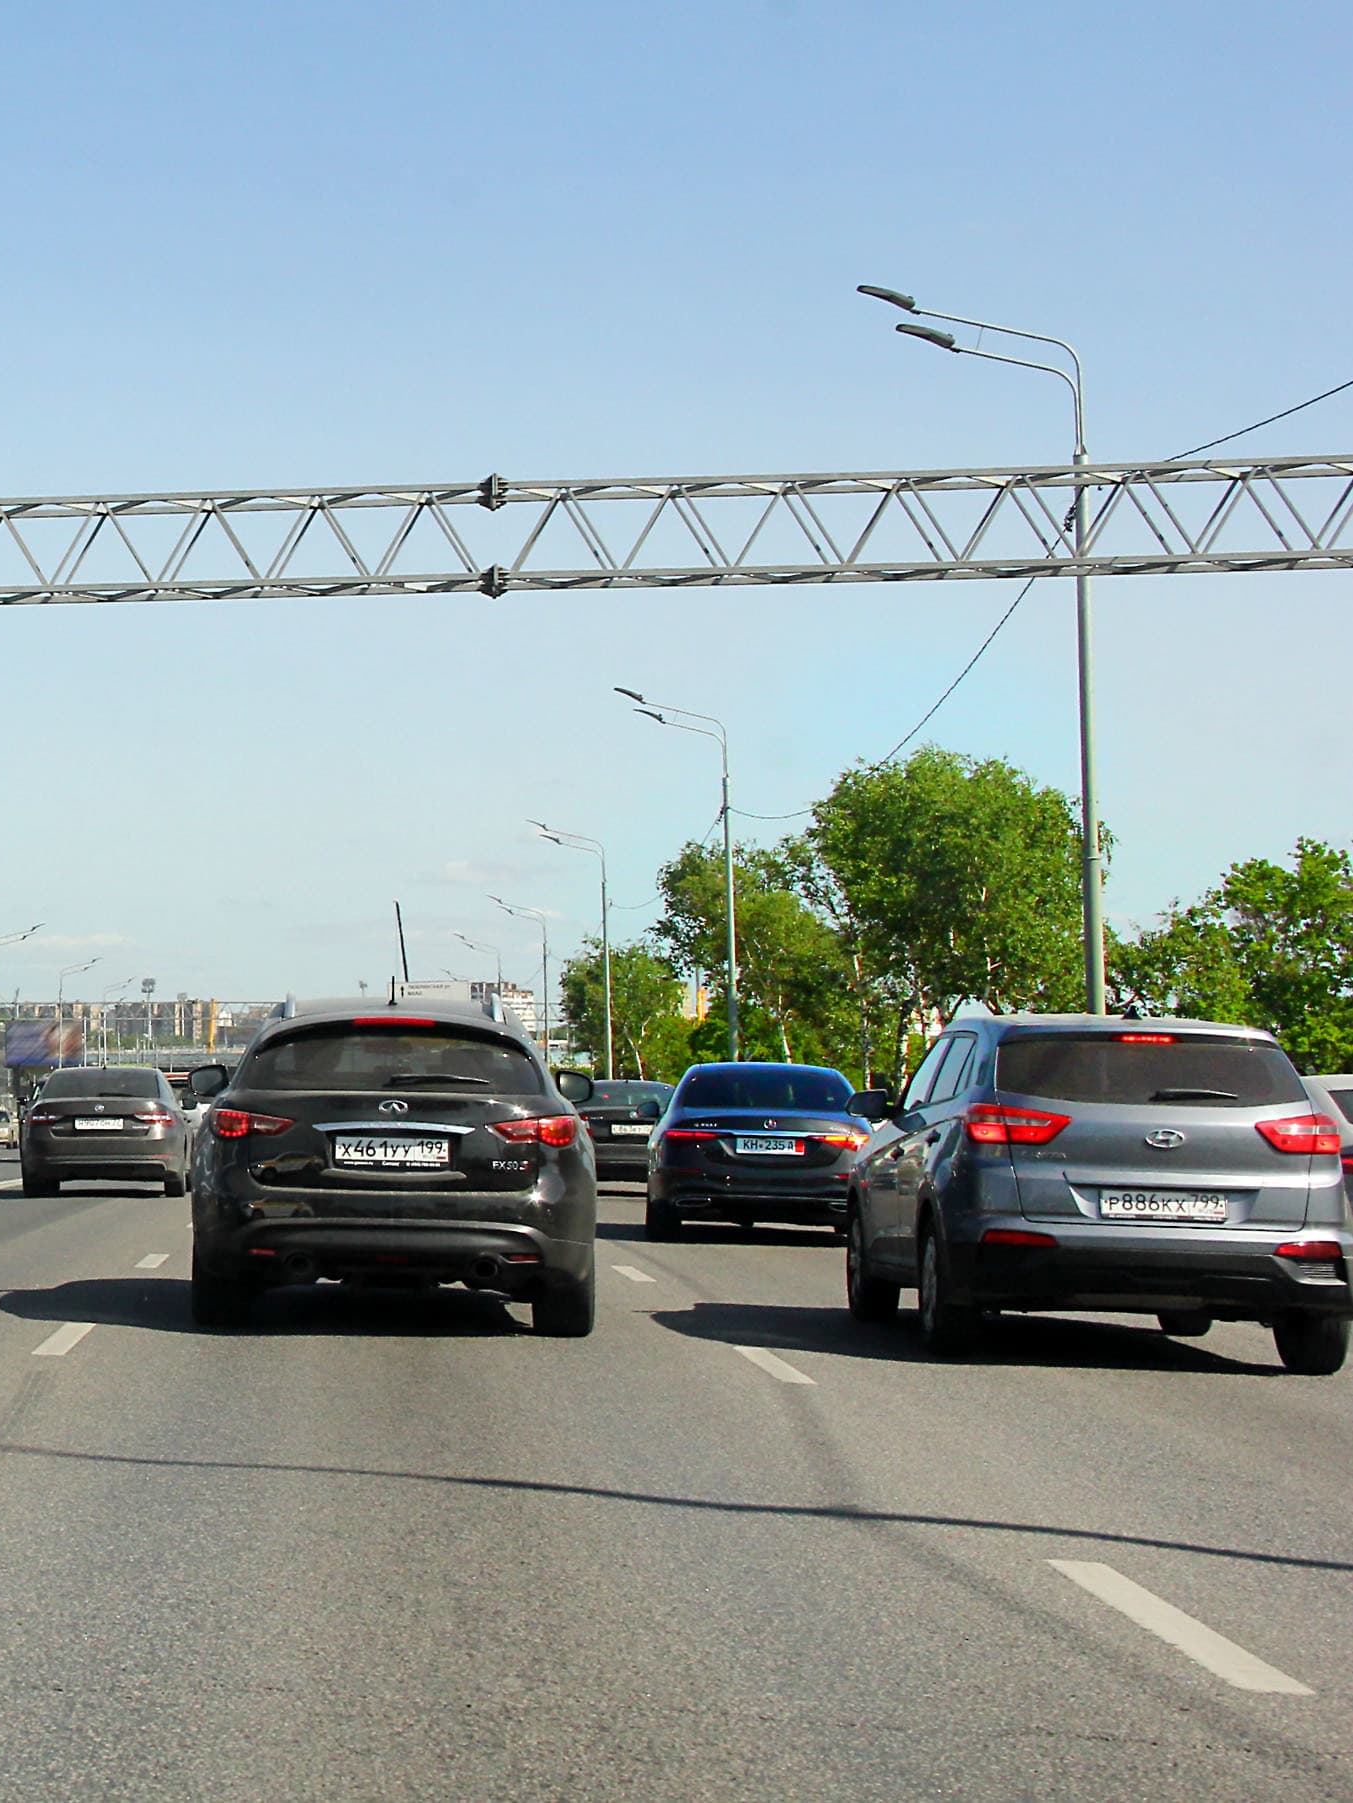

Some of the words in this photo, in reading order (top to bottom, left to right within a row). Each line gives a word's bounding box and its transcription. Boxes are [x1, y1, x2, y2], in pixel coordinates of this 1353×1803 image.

[417, 1140, 443, 1154] 199
[765, 1139, 785, 1150] 235
[1190, 1194, 1219, 1210] 799
